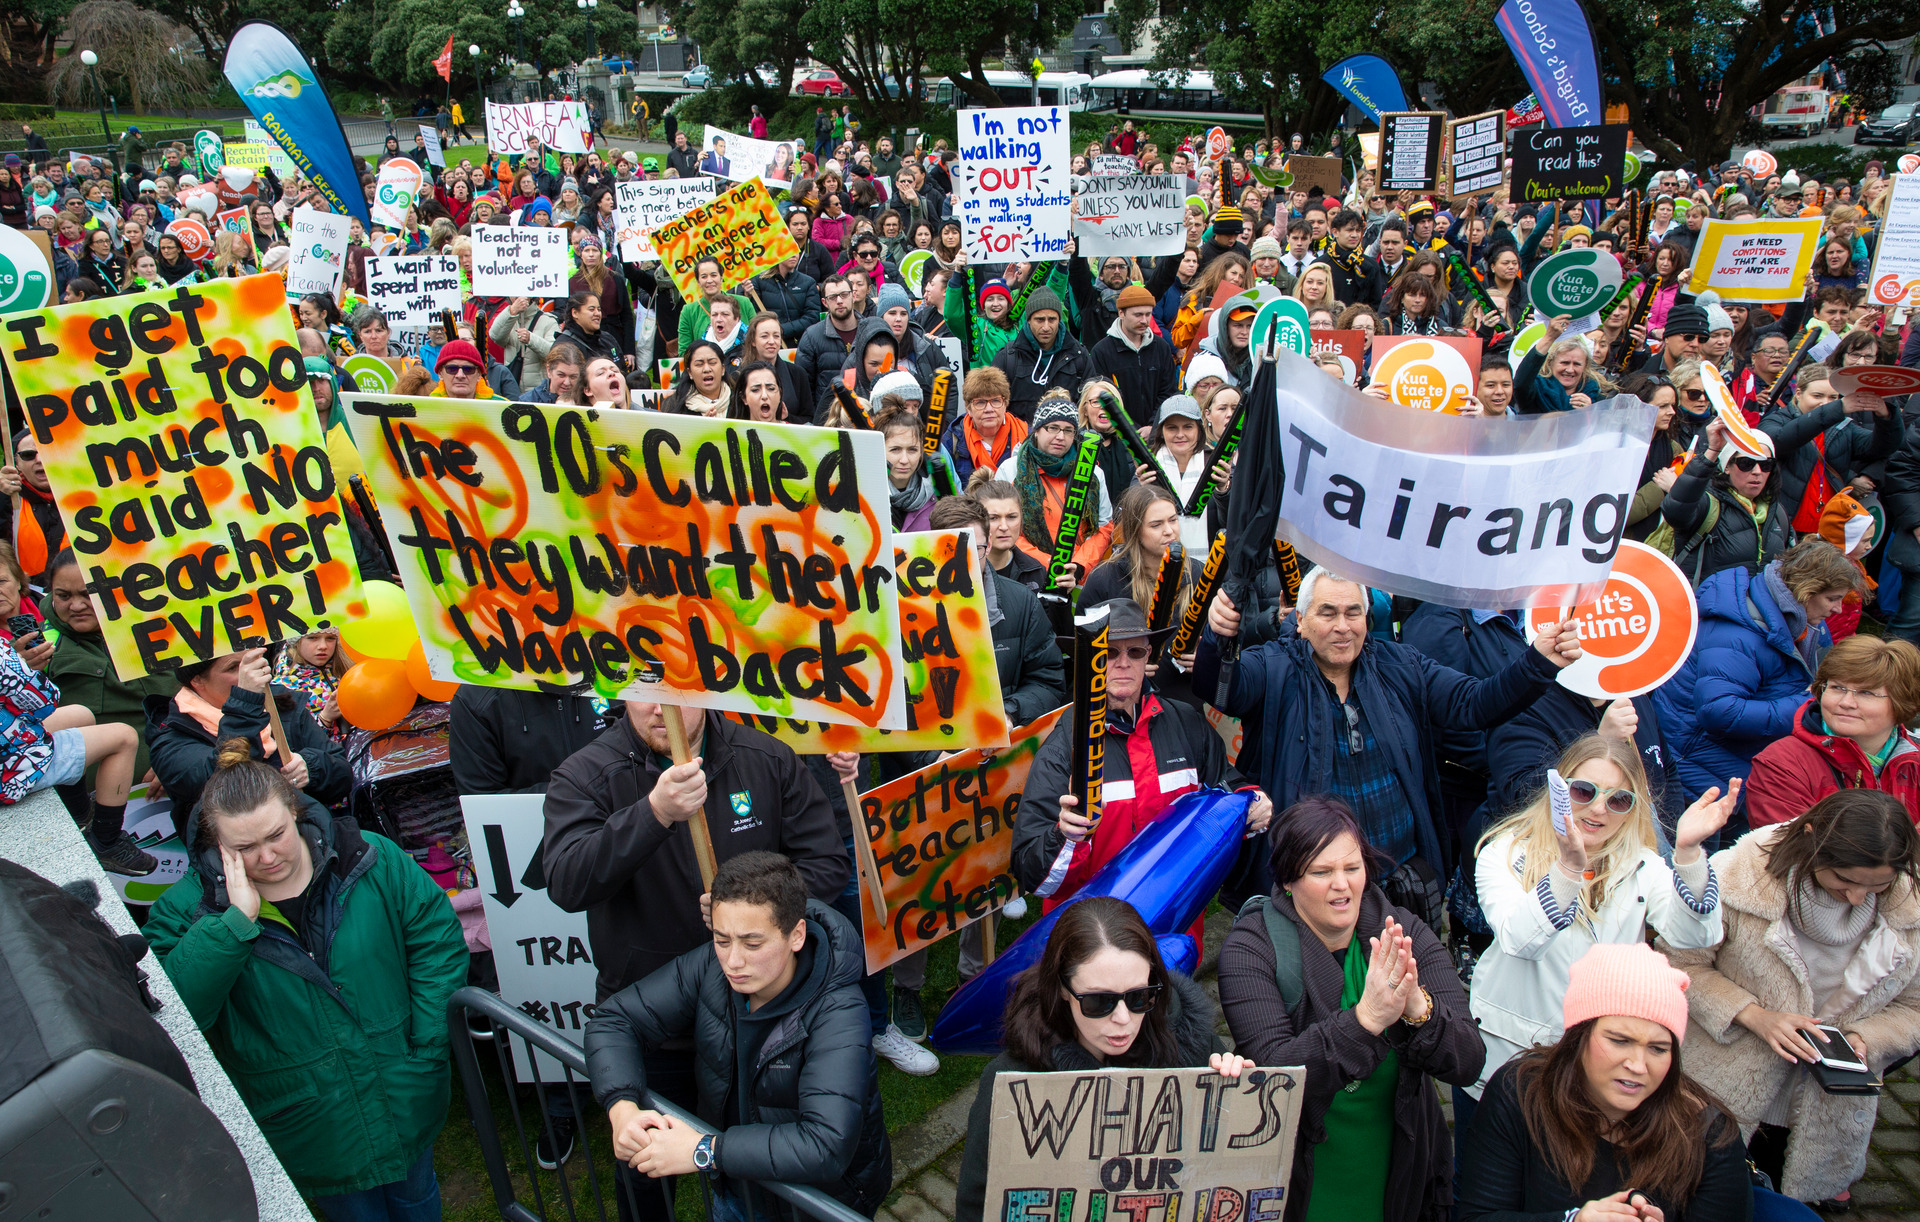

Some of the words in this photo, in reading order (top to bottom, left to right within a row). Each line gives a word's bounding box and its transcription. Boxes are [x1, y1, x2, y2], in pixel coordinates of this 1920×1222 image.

[973, 112, 1004, 136] I'm
[1017, 108, 1061, 135] not
[1460, 126, 1472, 135] Too
[1478, 121, 1495, 130] much
[226, 146, 265, 155] Recruit
[1458, 132, 1492, 148] addition!
[1530, 131, 1562, 150] Can
[1576, 136, 1599, 152] you
[228, 156, 266, 165] Retain
[960, 138, 1041, 165] walking
[1453, 155, 1464, 164] We
[1467, 149, 1483, 160] need
[1486, 145, 1503, 154] more
[1538, 152, 1571, 171] read
[1576, 151, 1602, 168] this?
[262, 112, 313, 171] RAUMATI
[312, 174, 349, 214] BEACH
[1103, 163, 1132, 172] teaching
[1457, 157, 1496, 175] subtraction!
[979, 166, 1038, 191] OUT
[1117, 176, 1139, 191] SAY
[1525, 178, 1561, 200] (You're
[617, 183, 644, 202] This
[680, 179, 714, 194] would
[964, 199, 980, 209] on
[989, 197, 1009, 212] my
[1016, 190, 1071, 207] students
[619, 203, 637, 214] be
[642, 202, 672, 214] more
[651, 198, 728, 246] Teachers
[731, 184, 757, 205] are
[1078, 197, 1119, 217] UNLESS
[1124, 194, 1149, 210] YOU
[1149, 193, 1181, 209] WILL
[627, 216, 636, 227] if
[644, 215, 650, 226] I
[966, 214, 981, 224] I'm
[988, 211, 1032, 226] walking
[1147, 221, 1183, 236] WEST
[295, 221, 314, 233] are
[321, 223, 337, 239] the
[475, 227, 539, 246] Teaching
[547, 231, 560, 244] is
[703, 223, 725, 241] an
[977, 225, 1023, 252] for
[177, 233, 197, 250] time
[496, 243, 521, 258] not
[530, 249, 541, 258] a
[674, 209, 772, 274] endangered
[1732, 248, 1787, 256] CONDITIONS
[1742, 238, 1755, 246] WE
[1756, 238, 1782, 246] NEED
[293, 248, 308, 264] of
[723, 240, 767, 271] ecies
[1734, 257, 1757, 265] THAT
[368, 257, 383, 278] I
[394, 256, 433, 275] want
[439, 256, 457, 274] to
[477, 260, 539, 275] volunteer
[1717, 267, 1742, 275] JUST
[1767, 267, 1790, 275] FAIR
[371, 276, 418, 298] spend
[424, 278, 458, 292] more
[527, 273, 559, 291] job!
[1557, 273, 1584, 284] Kua
[1557, 282, 1579, 293] tae
[1580, 283, 1594, 294] te
[407, 294, 436, 311] with
[1562, 292, 1581, 303] wā
[7, 317, 58, 361] I
[88, 287, 204, 368] get
[363, 377, 378, 387] It's
[1399, 371, 1428, 385] Kua
[26, 357, 177, 444] paid
[192, 345, 307, 404] too
[930, 368, 951, 412] NZEI
[1402, 384, 1426, 397] tae
[1428, 385, 1443, 397] te
[1410, 396, 1431, 409] wā
[926, 411, 943, 435] TE
[353, 401, 484, 487] The
[501, 403, 637, 497] 90's
[642, 427, 860, 513] Called
[1074, 432, 1101, 483] NZEI
[73, 476, 212, 555] said
[242, 446, 336, 515] NO
[1066, 485, 1087, 511] TE
[86, 511, 341, 621] teacher
[398, 505, 575, 626] they
[569, 522, 713, 599] want
[714, 523, 893, 614] their
[1202, 531, 1227, 581] NZEI
[1280, 547, 1298, 572] TE
[1192, 577, 1212, 603] TE
[1595, 590, 1634, 616] It's
[132, 570, 331, 674] EVER!
[1575, 612, 1647, 641] time
[688, 617, 873, 708] back
[1088, 744, 1105, 778] TE
[862, 755, 998, 843] Better
[863, 790, 1021, 888] teache
[893, 872, 1026, 951] reten
[516, 937, 592, 967] TRA
[1009, 1070, 1296, 1160] WHAT'S
[1100, 1157, 1184, 1193] OUR
